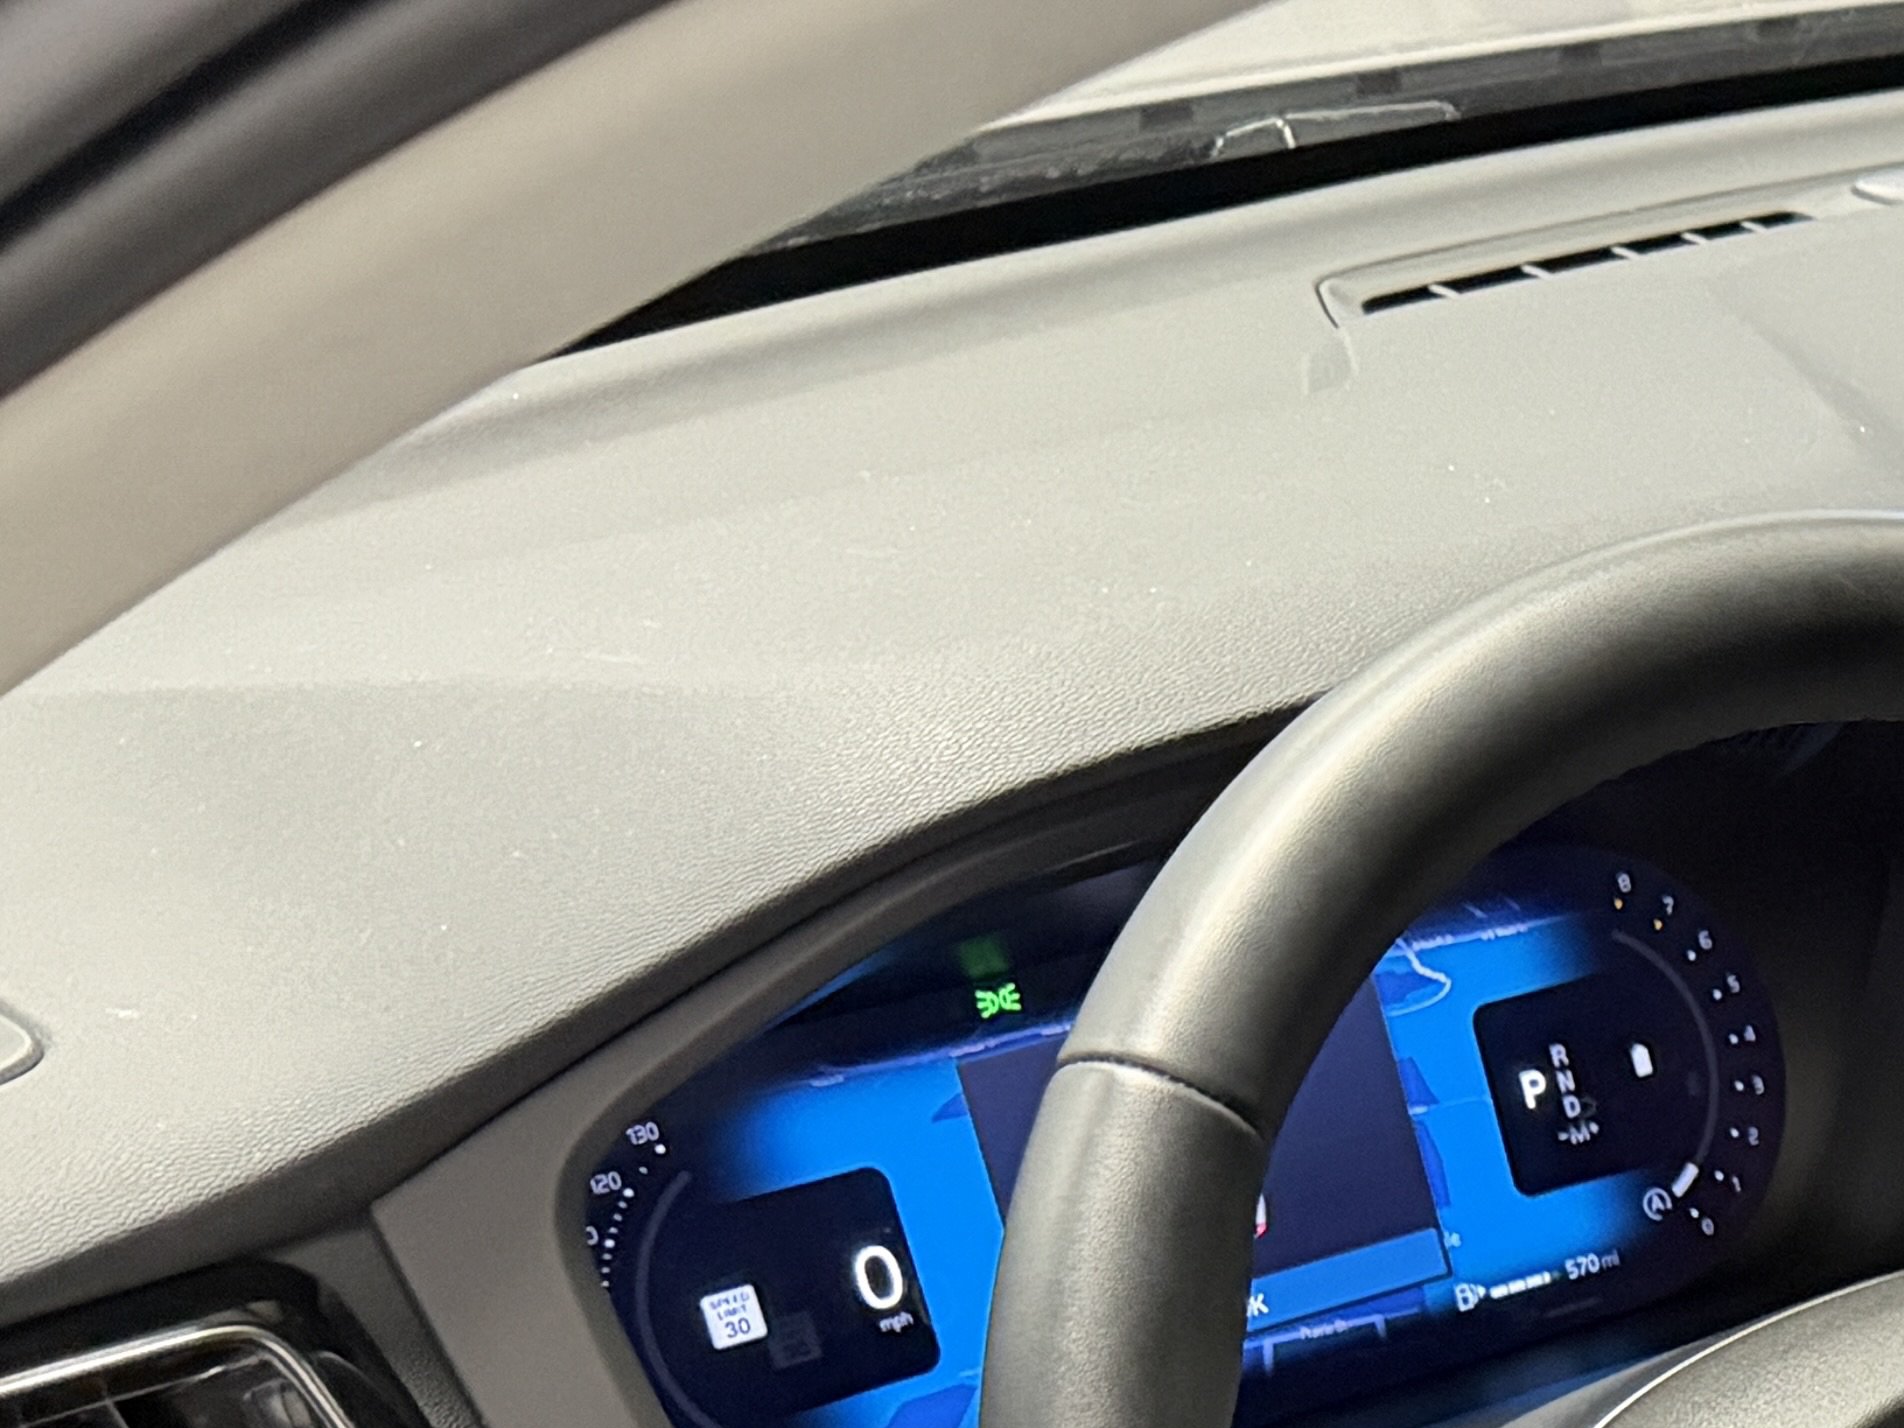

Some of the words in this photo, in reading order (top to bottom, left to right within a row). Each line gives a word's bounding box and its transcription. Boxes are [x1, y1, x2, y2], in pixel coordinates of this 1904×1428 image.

[1615, 872, 1632, 893] 8
[1662, 895, 1675, 916] 7
[1698, 930, 1714, 951] 6
[1726, 974, 1742, 994] 5
[1743, 1025, 1757, 1043] 4
[1548, 1042, 1570, 1069] R
[1518, 1068, 1548, 1110] P
[1556, 1068, 1576, 1094] N
[1752, 1074, 1765, 1096] 3
[1561, 1094, 1582, 1119] D
[625, 1120, 661, 1146] 130
[1568, 1121, 1592, 1145] M
[1747, 1126, 1760, 1147] 2
[589, 1170, 623, 1196] 120
[1730, 1175, 1742, 1193] 1
[1700, 1216, 1715, 1236] 0
[1564, 1252, 1600, 1281] 570
[1599, 1249, 1621, 1270] mi
[854, 1244, 905, 1311] 0
[709, 1291, 751, 1311] SPEED
[716, 1303, 749, 1322] LIMIT
[878, 1310, 915, 1334] mph
[724, 1316, 752, 1339] 30
